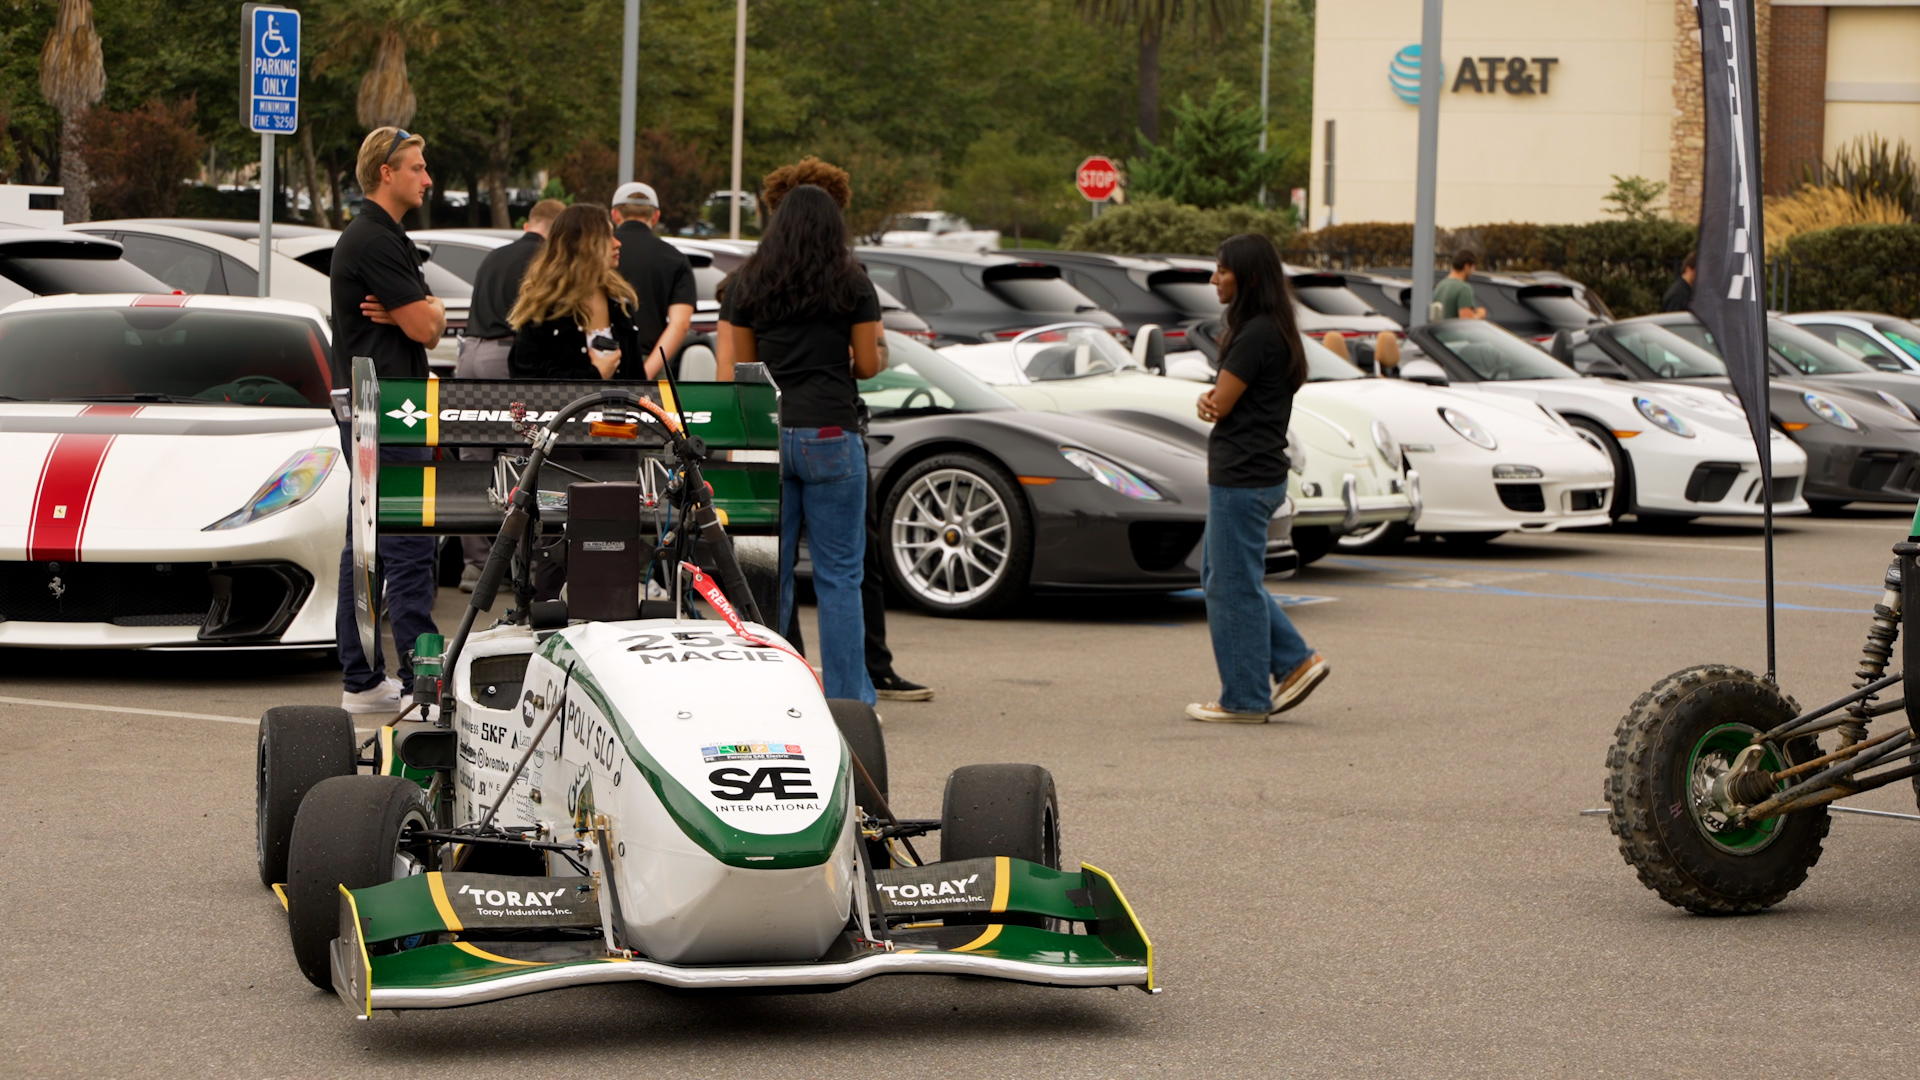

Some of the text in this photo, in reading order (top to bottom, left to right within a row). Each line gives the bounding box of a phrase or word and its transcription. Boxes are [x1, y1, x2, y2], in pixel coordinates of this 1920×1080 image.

[256, 57, 296, 77] PARKING
[1452, 57, 1559, 94] AT&T
[262, 77, 288, 96] ONLY
[260, 100, 290, 114] MINIMUM
[254, 114, 294, 128] FINE $250
[1080, 170, 1115, 188] STOP
[707, 588, 750, 638] REMOVE
[639, 650, 784, 665] MACIE
[481, 722, 507, 744] SKF
[566, 700, 595, 750] POLY
[594, 725, 614, 772] SLO
[484, 752, 510, 773] brembo
[708, 766, 818, 801] SAE
[716, 803, 822, 813] INTERNATIONAL
[892, 899, 918, 907] Toray
[920, 896, 968, 905] Industries,
[477, 908, 504, 917] Toray
[506, 908, 554, 916] Industries,
